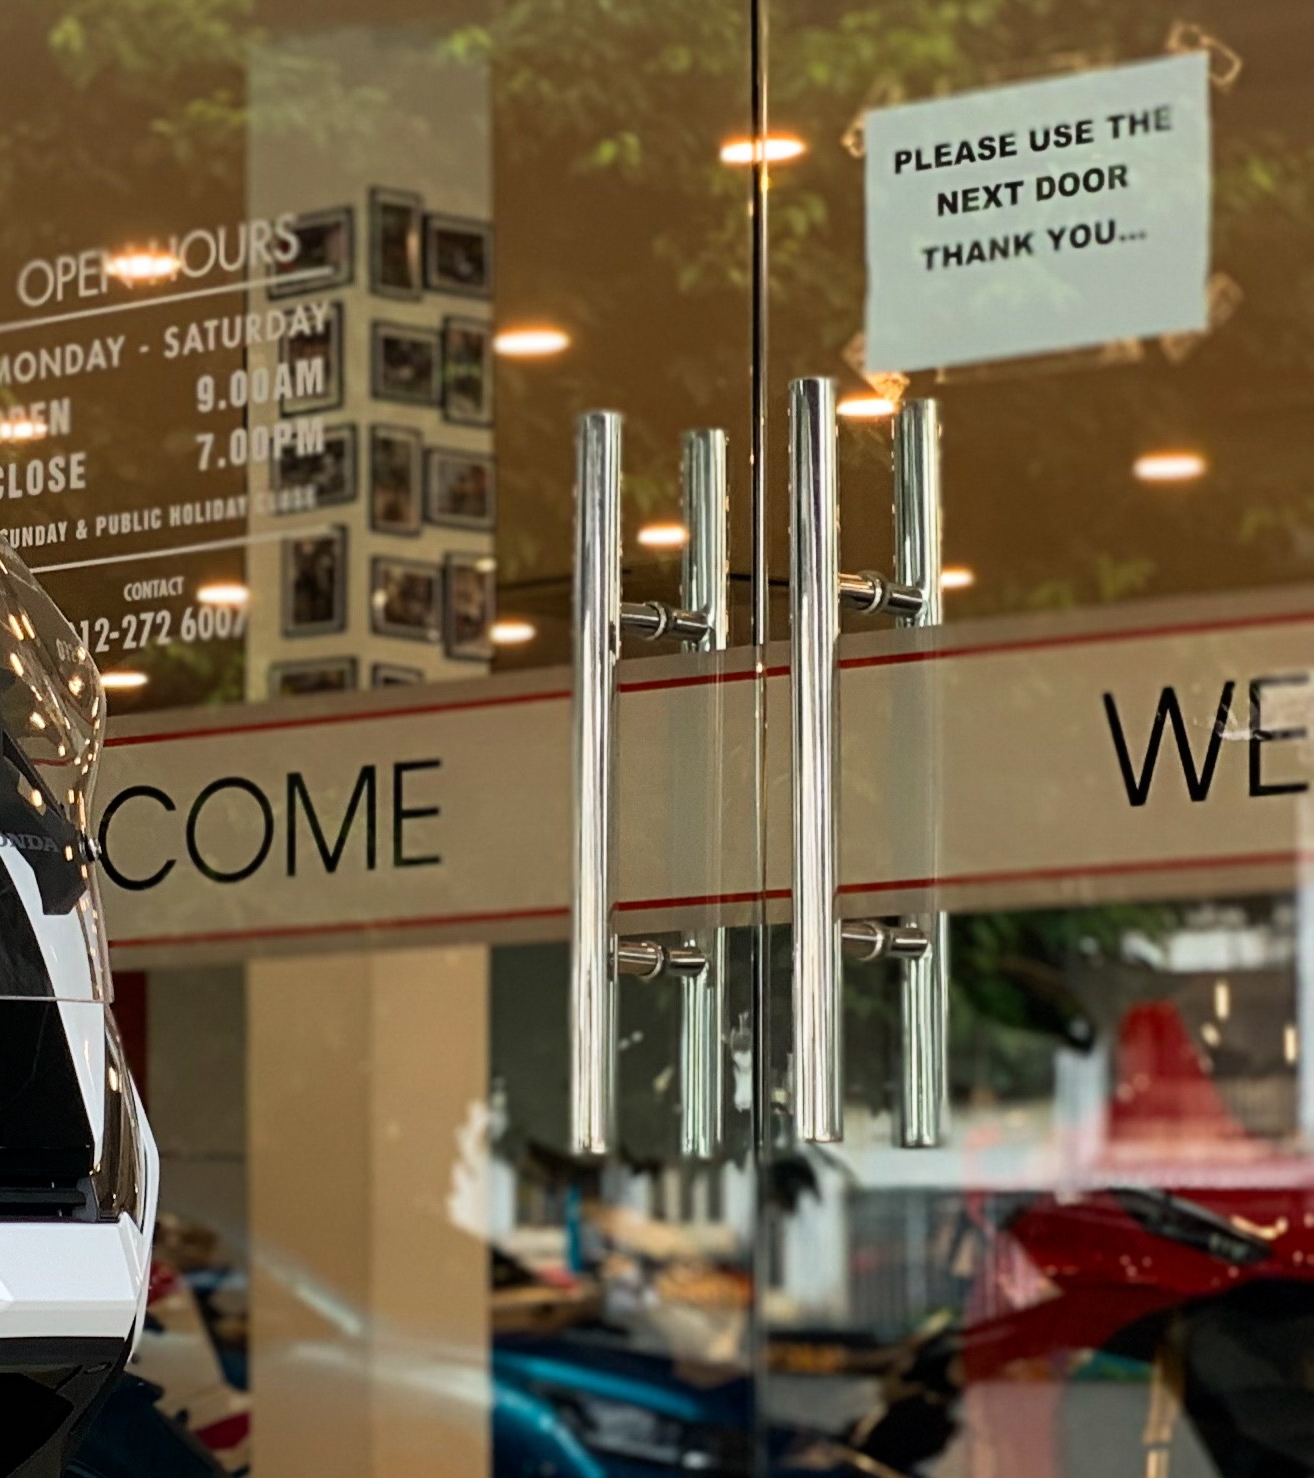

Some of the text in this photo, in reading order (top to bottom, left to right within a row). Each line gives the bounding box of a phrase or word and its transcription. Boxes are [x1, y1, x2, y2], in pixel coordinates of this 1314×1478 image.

[893, 104, 1173, 174] PLEASE USE THE
[936, 164, 1129, 217] NEXT DOOR
[922, 231, 1034, 271] THANK
[163, 302, 328, 359] SATURDAY
[196, 357, 324, 413] 9.00AM
[195, 417, 324, 471] 7.00PM
[75, 518, 88, 540] &
[96, 507, 162, 538] PUBLIC
[170, 494, 247, 527] HOLIDAY
[123, 575, 185, 602] CONTACT
[1102, 674, 1310, 807] WE
